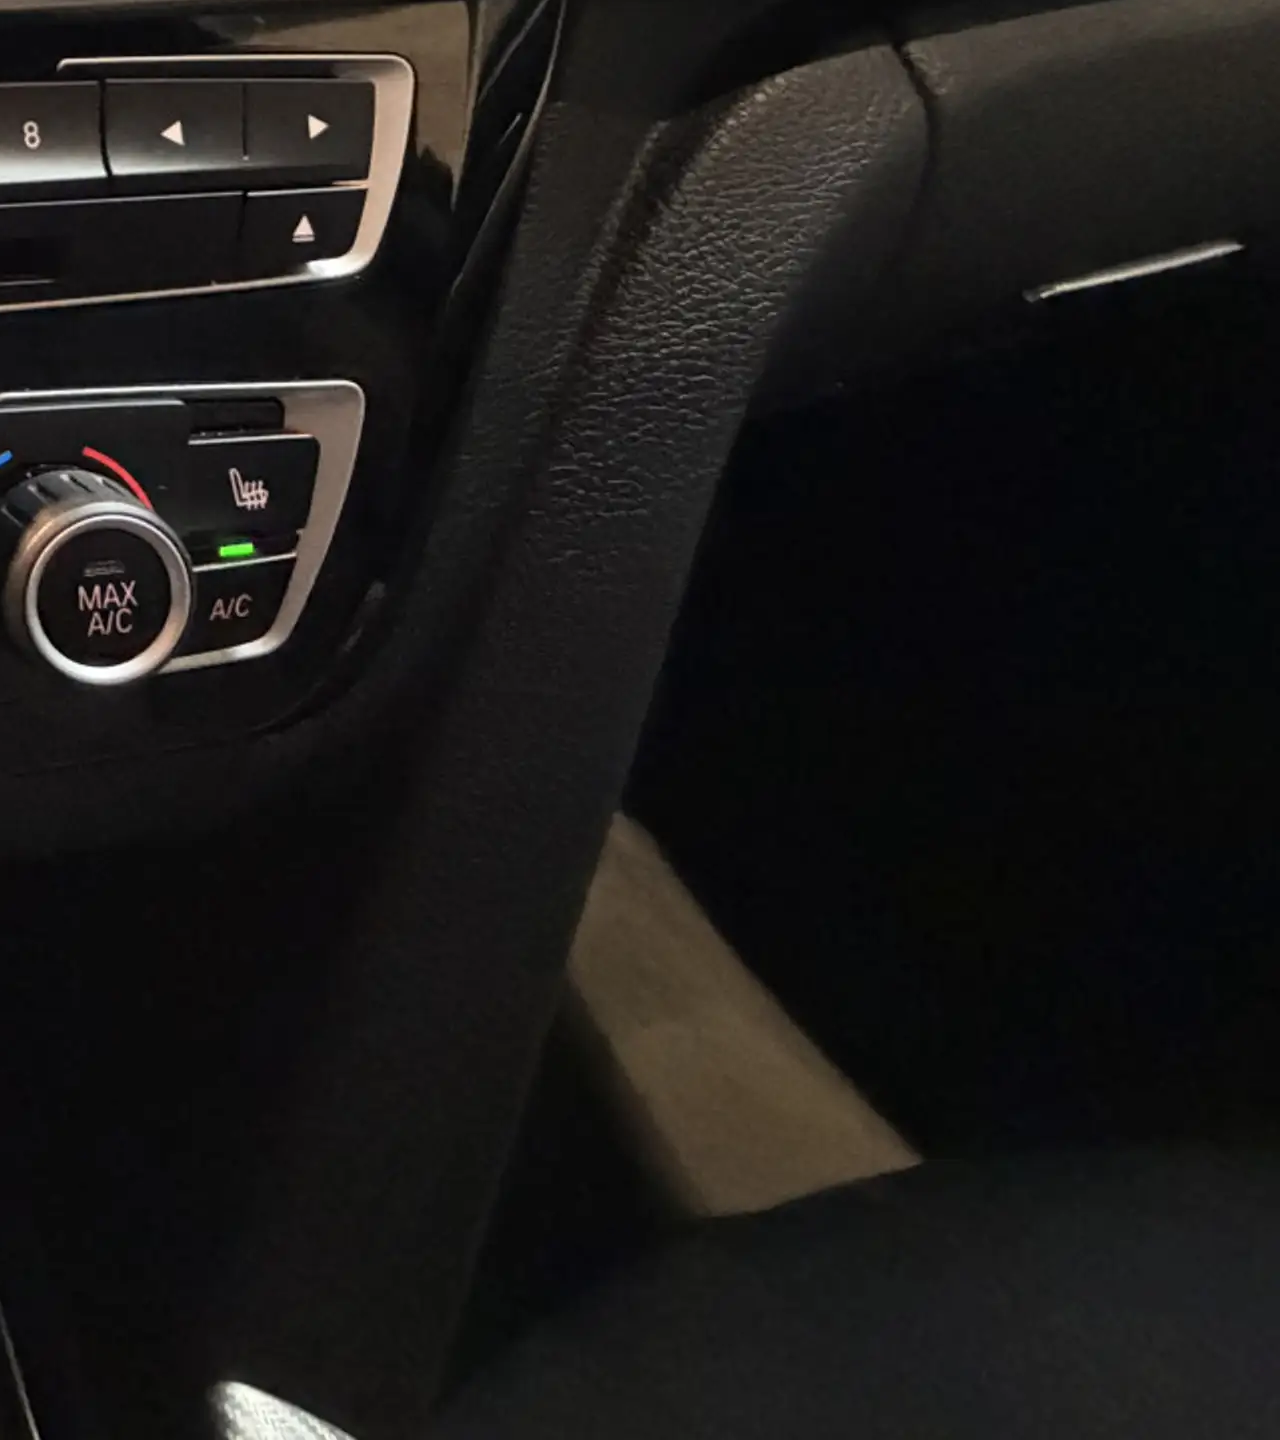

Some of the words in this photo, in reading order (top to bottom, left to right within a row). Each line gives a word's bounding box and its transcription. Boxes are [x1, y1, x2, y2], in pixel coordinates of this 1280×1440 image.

[23, 121, 41, 149] 8
[77, 579, 138, 611] MAX
[209, 593, 253, 621] A/C
[88, 607, 133, 638] A/C
